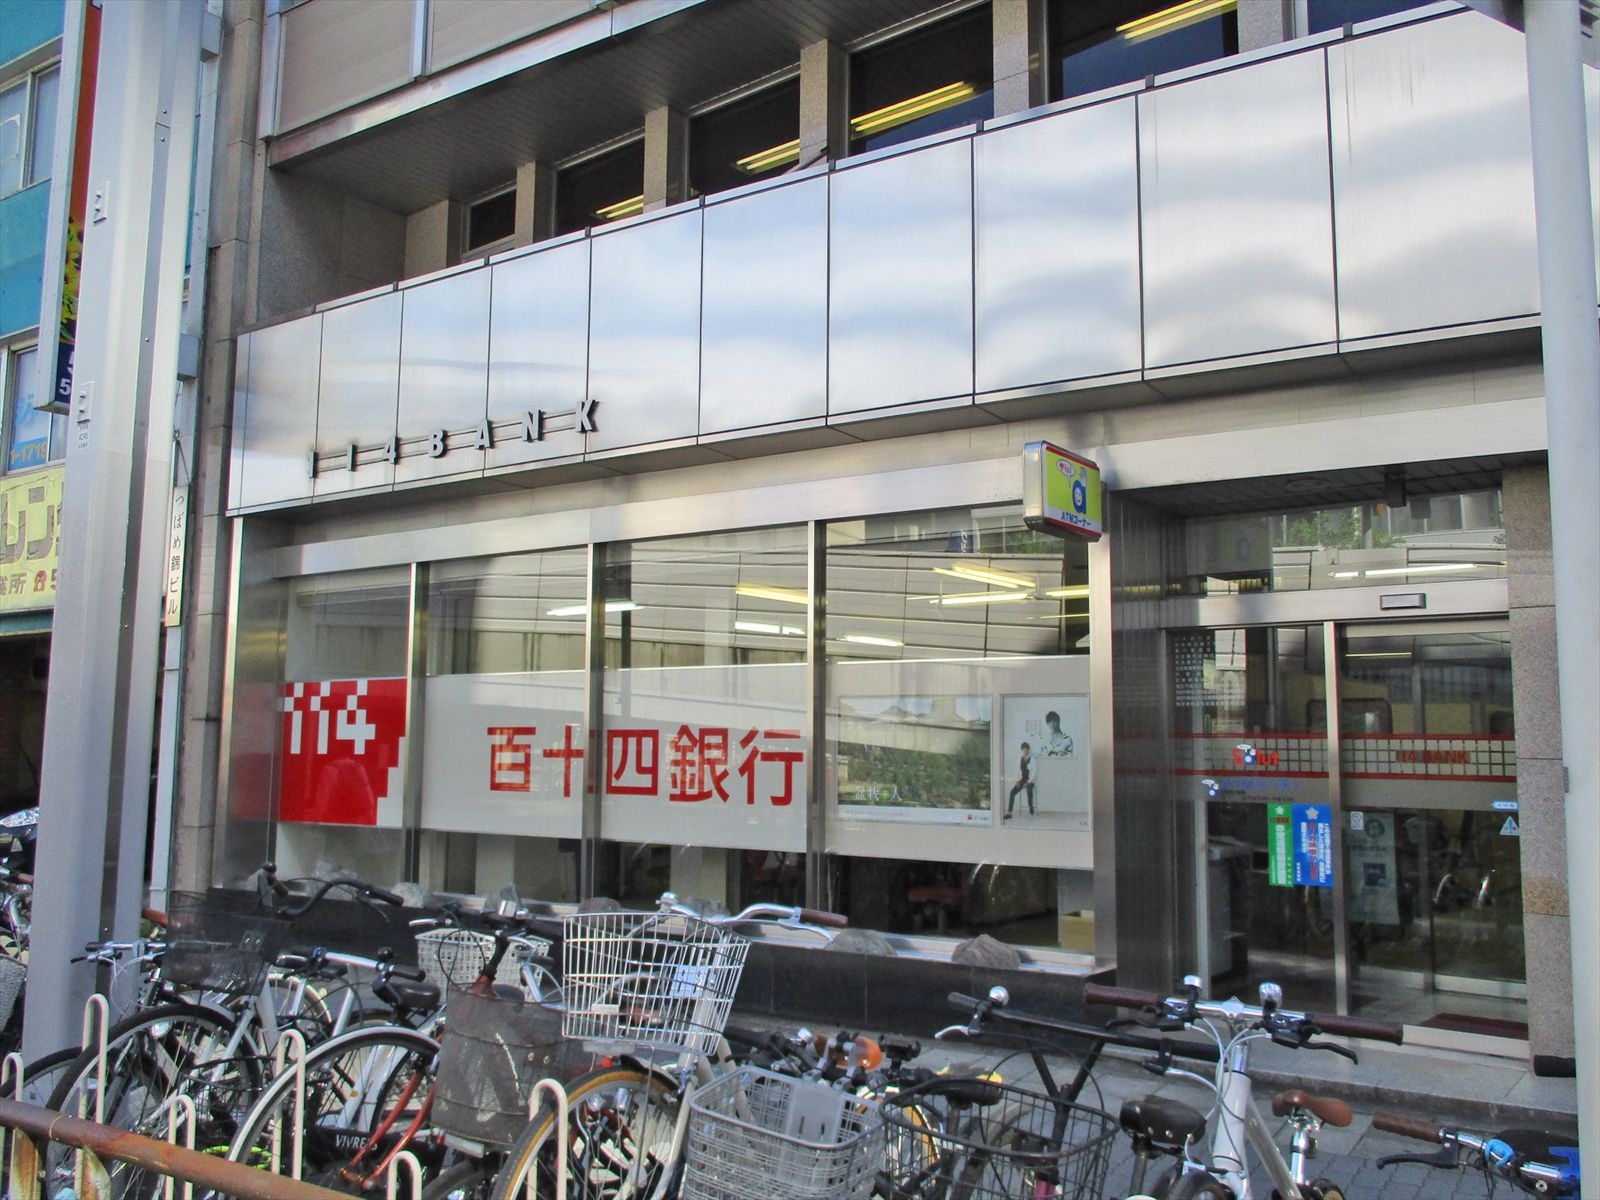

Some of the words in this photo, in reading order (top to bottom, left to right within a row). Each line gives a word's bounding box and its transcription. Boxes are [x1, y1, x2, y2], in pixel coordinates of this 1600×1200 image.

[1061, 511, 1091, 527] ATMコーナー
[284, 680, 376, 755] 114
[487, 724, 804, 806] 百十四銀行
[1423, 750, 1472, 764] BANK
